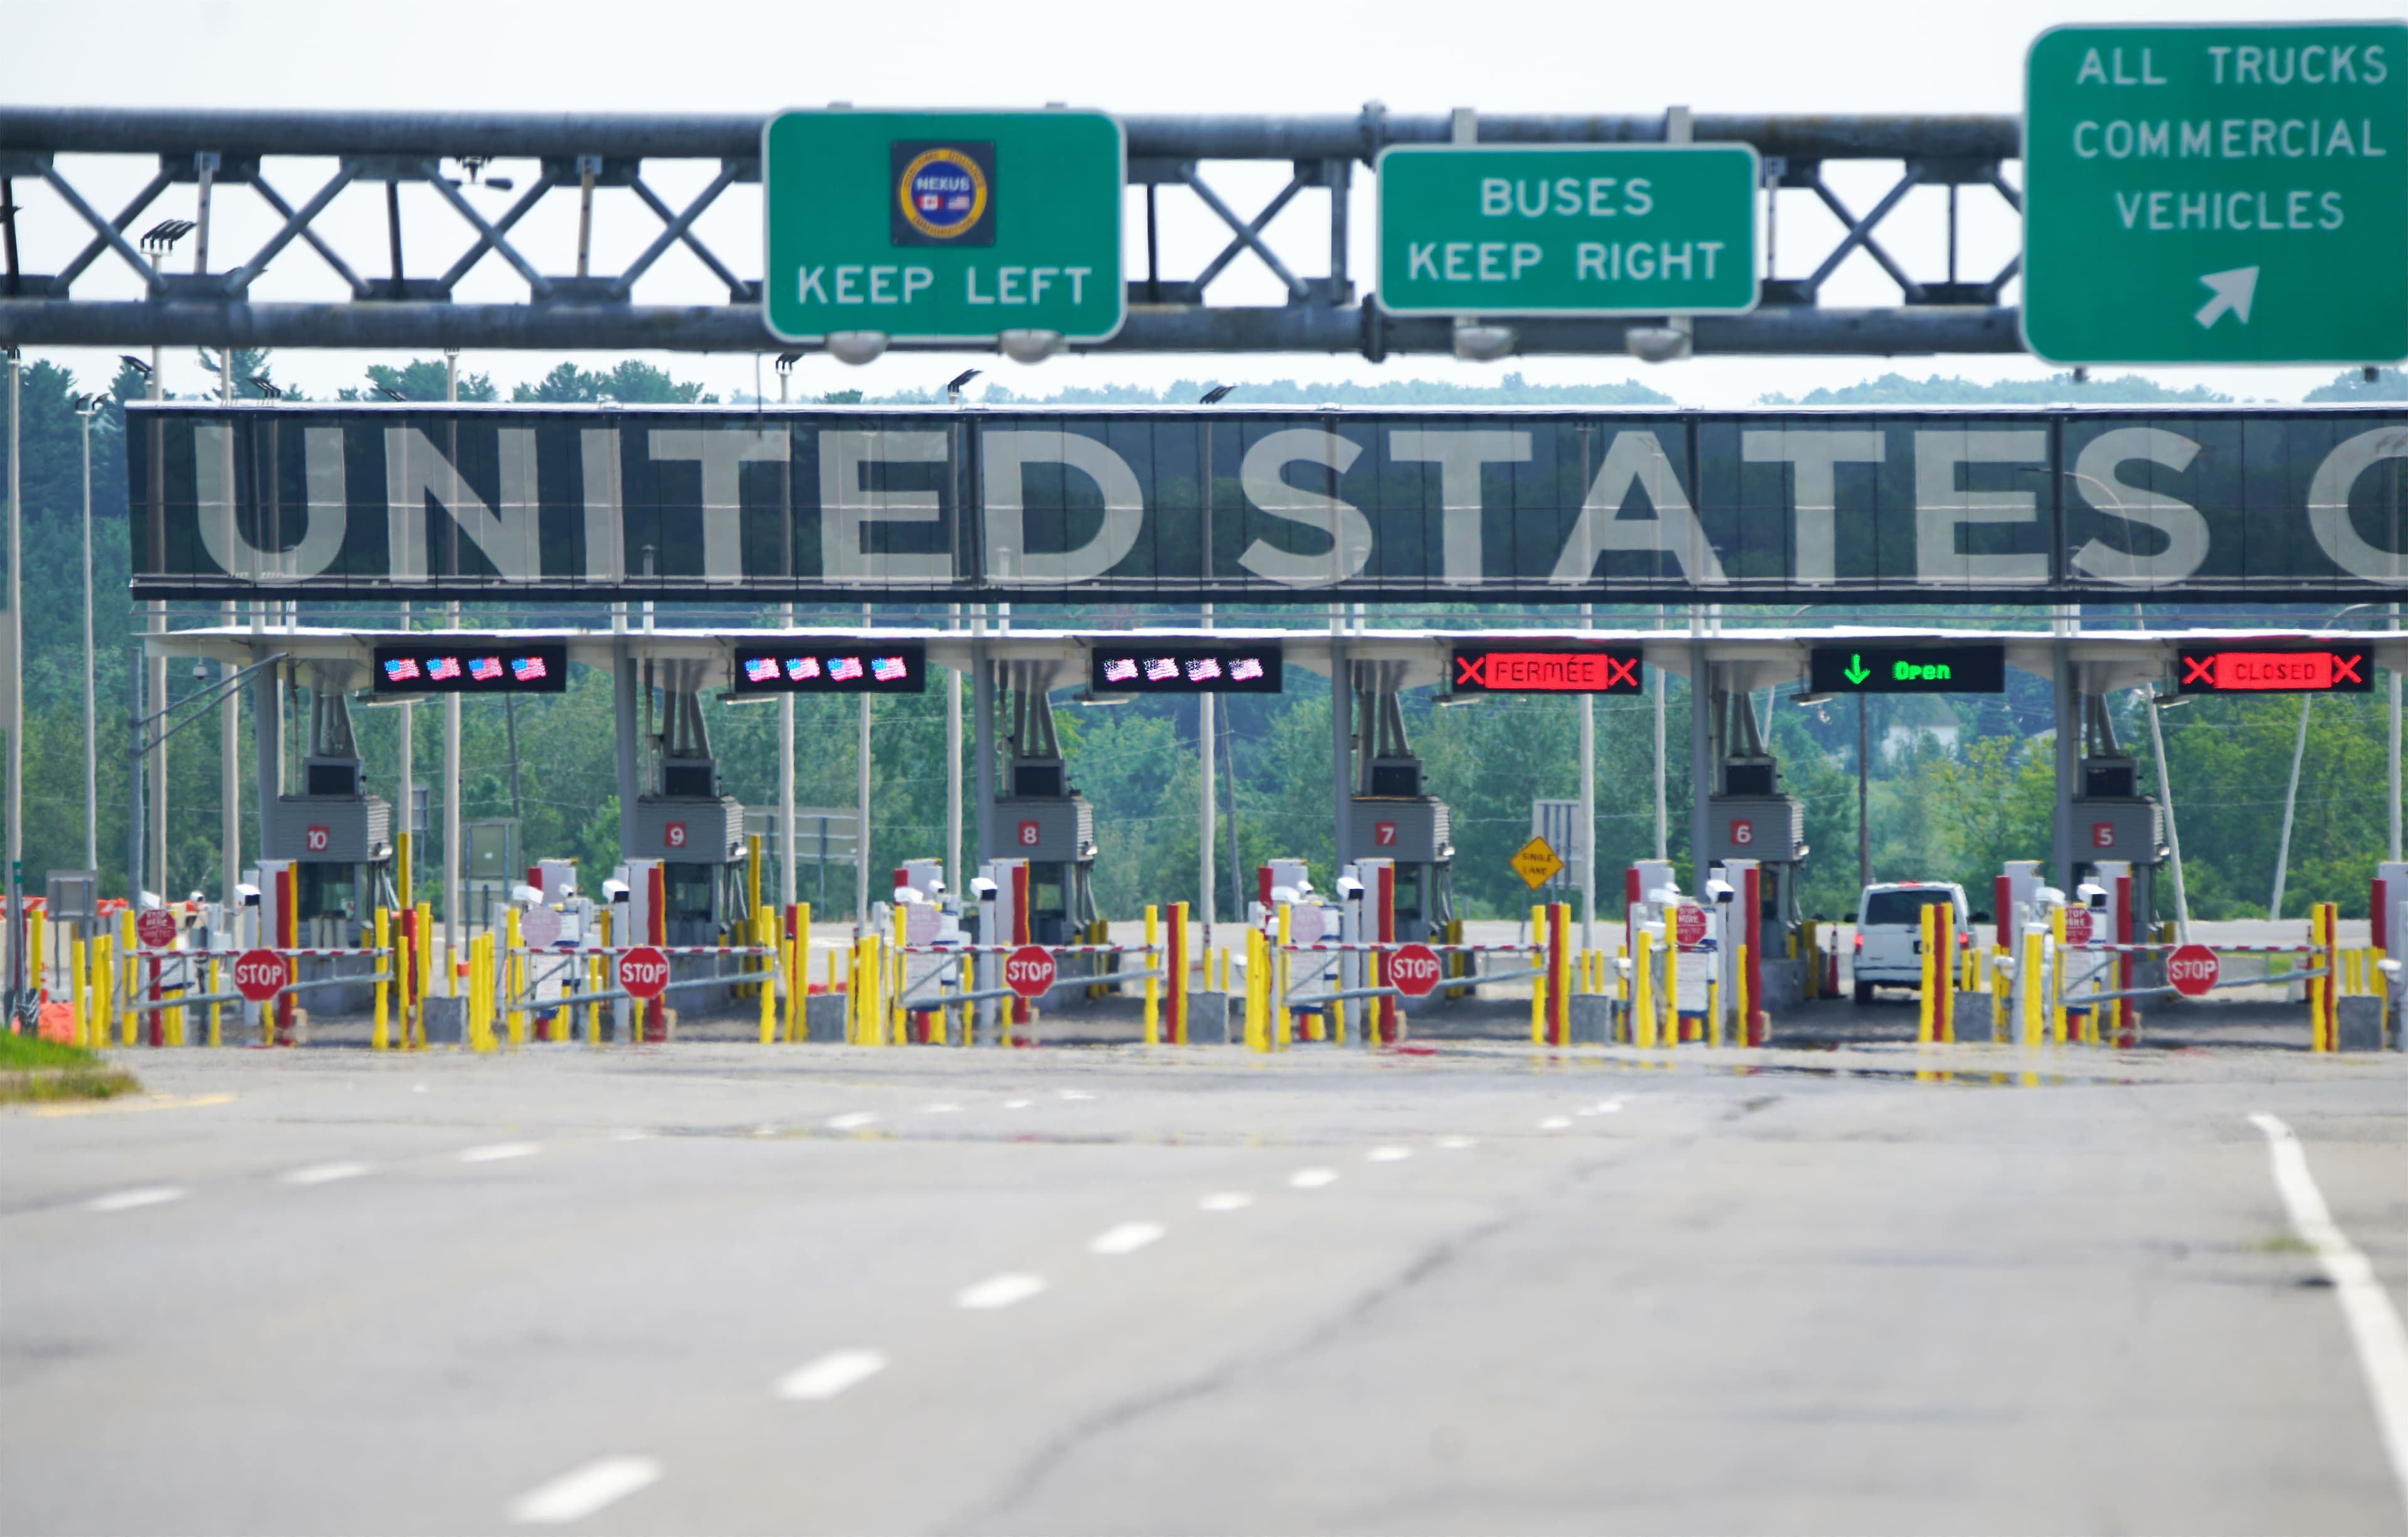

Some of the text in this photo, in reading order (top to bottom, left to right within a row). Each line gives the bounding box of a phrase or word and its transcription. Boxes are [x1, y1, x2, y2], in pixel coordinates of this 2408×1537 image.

[2076, 45, 2388, 85] ALL TRUCKS
[2073, 118, 2387, 158] COMMERCIAL
[916, 176, 970, 191] NEXUS
[1481, 178, 1653, 216] BUSES
[2115, 190, 2344, 230] VEHICLES
[1408, 241, 1725, 281] KEEP RIGHT
[797, 266, 1091, 304] KEEP LEFT
[194, 426, 1143, 586] UNITED
[1238, 427, 2210, 588] STATES
[1496, 657, 1594, 683] FERMÉE
[1893, 660, 1951, 680] Open
[2236, 663, 2316, 680] CLOSED
[309, 832, 327, 849] 10
[670, 827, 684, 845] 9
[1024, 827, 1037, 844] 8
[1382, 827, 1394, 844] 7
[1736, 825, 1751, 843] 6
[2099, 828, 2113, 845] 5
[236, 964, 282, 985] STOP
[621, 963, 668, 983] STOP
[1008, 961, 1052, 981] STOP
[1393, 958, 1439, 980] STOP
[2171, 960, 2217, 980] STOP
